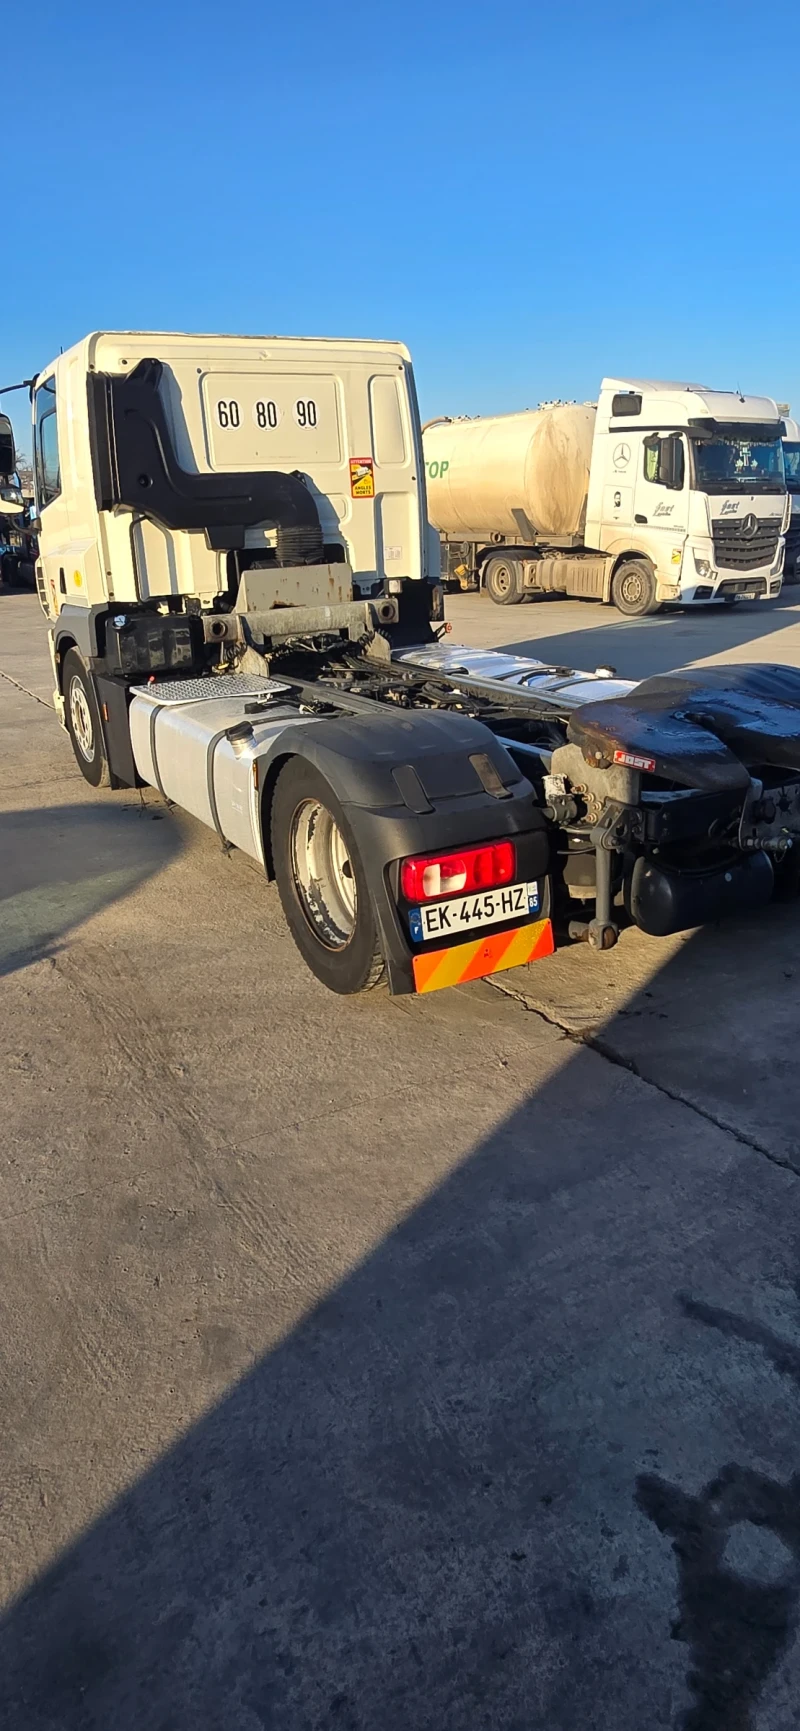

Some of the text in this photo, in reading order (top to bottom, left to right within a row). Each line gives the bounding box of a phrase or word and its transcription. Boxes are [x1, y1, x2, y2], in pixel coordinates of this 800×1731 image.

[218, 400, 240, 428] 60
[256, 401, 277, 428] 80
[296, 400, 317, 427] 90
[425, 461, 449, 479] OP
[617, 753, 651, 769] JOST
[425, 887, 526, 933] EK-445-HZ
[529, 896, 538, 908] 85
[414, 926, 419, 935] F
